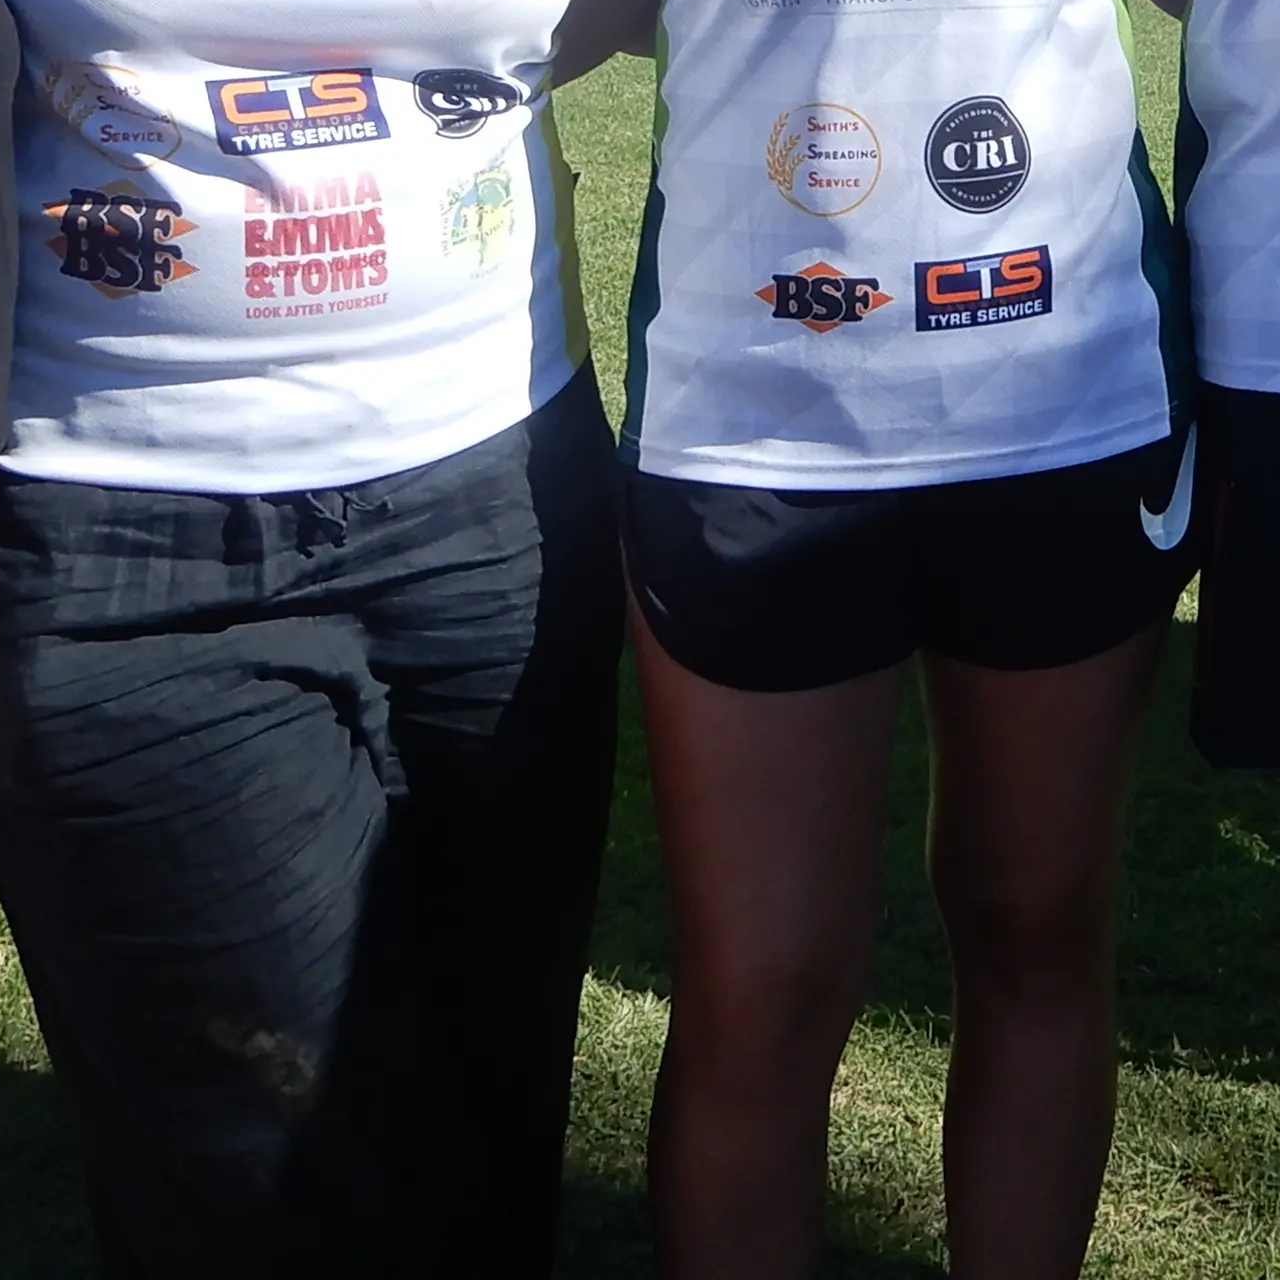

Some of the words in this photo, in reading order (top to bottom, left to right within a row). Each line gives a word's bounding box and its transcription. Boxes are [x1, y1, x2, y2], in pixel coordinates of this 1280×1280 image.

[220, 70, 369, 126] CTS
[230, 131, 287, 153] TYRE
[291, 121, 379, 147] SERVICE
[237, 113, 366, 136] CANOWINDRA
[942, 134, 1019, 172] CRI
[925, 249, 1044, 305] CTS
[246, 306, 282, 319] LOOK
[284, 303, 324, 317] AFTER
[328, 292, 389, 314] YOURSELF
[770, 271, 880, 323] BSF
[928, 311, 973, 327] TYRE
[976, 299, 1044, 324] SERVICE
